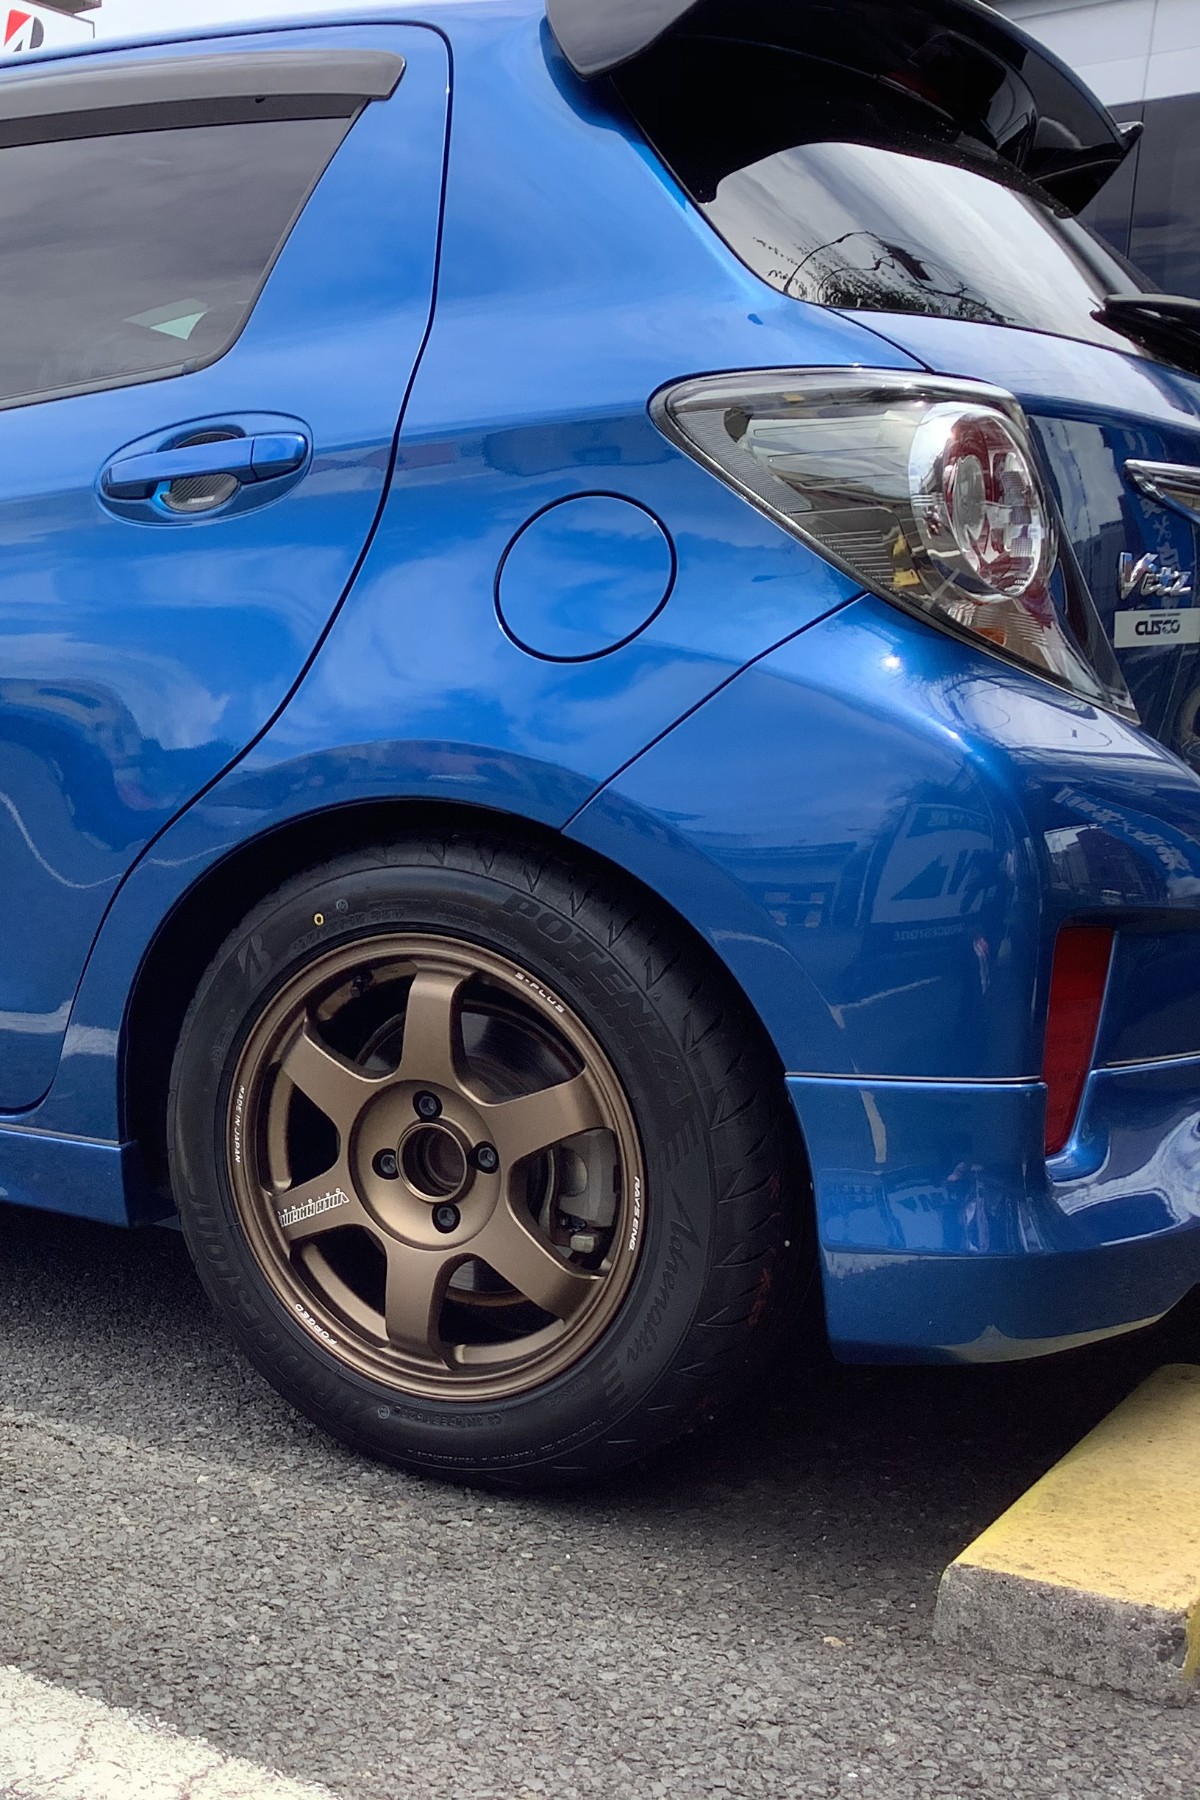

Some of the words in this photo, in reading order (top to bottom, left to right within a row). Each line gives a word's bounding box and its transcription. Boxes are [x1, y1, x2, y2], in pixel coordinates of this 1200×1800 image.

[1118, 551, 1192, 600] Vitz
[1135, 619, 1180, 636] CUSCO
[514, 970, 568, 1014] S-PLUS
[235, 1085, 245, 1113] MADE
[234, 1114, 241, 1126] IN
[233, 1127, 241, 1163] JAPAN
[293, 1302, 338, 1346] FORGED
